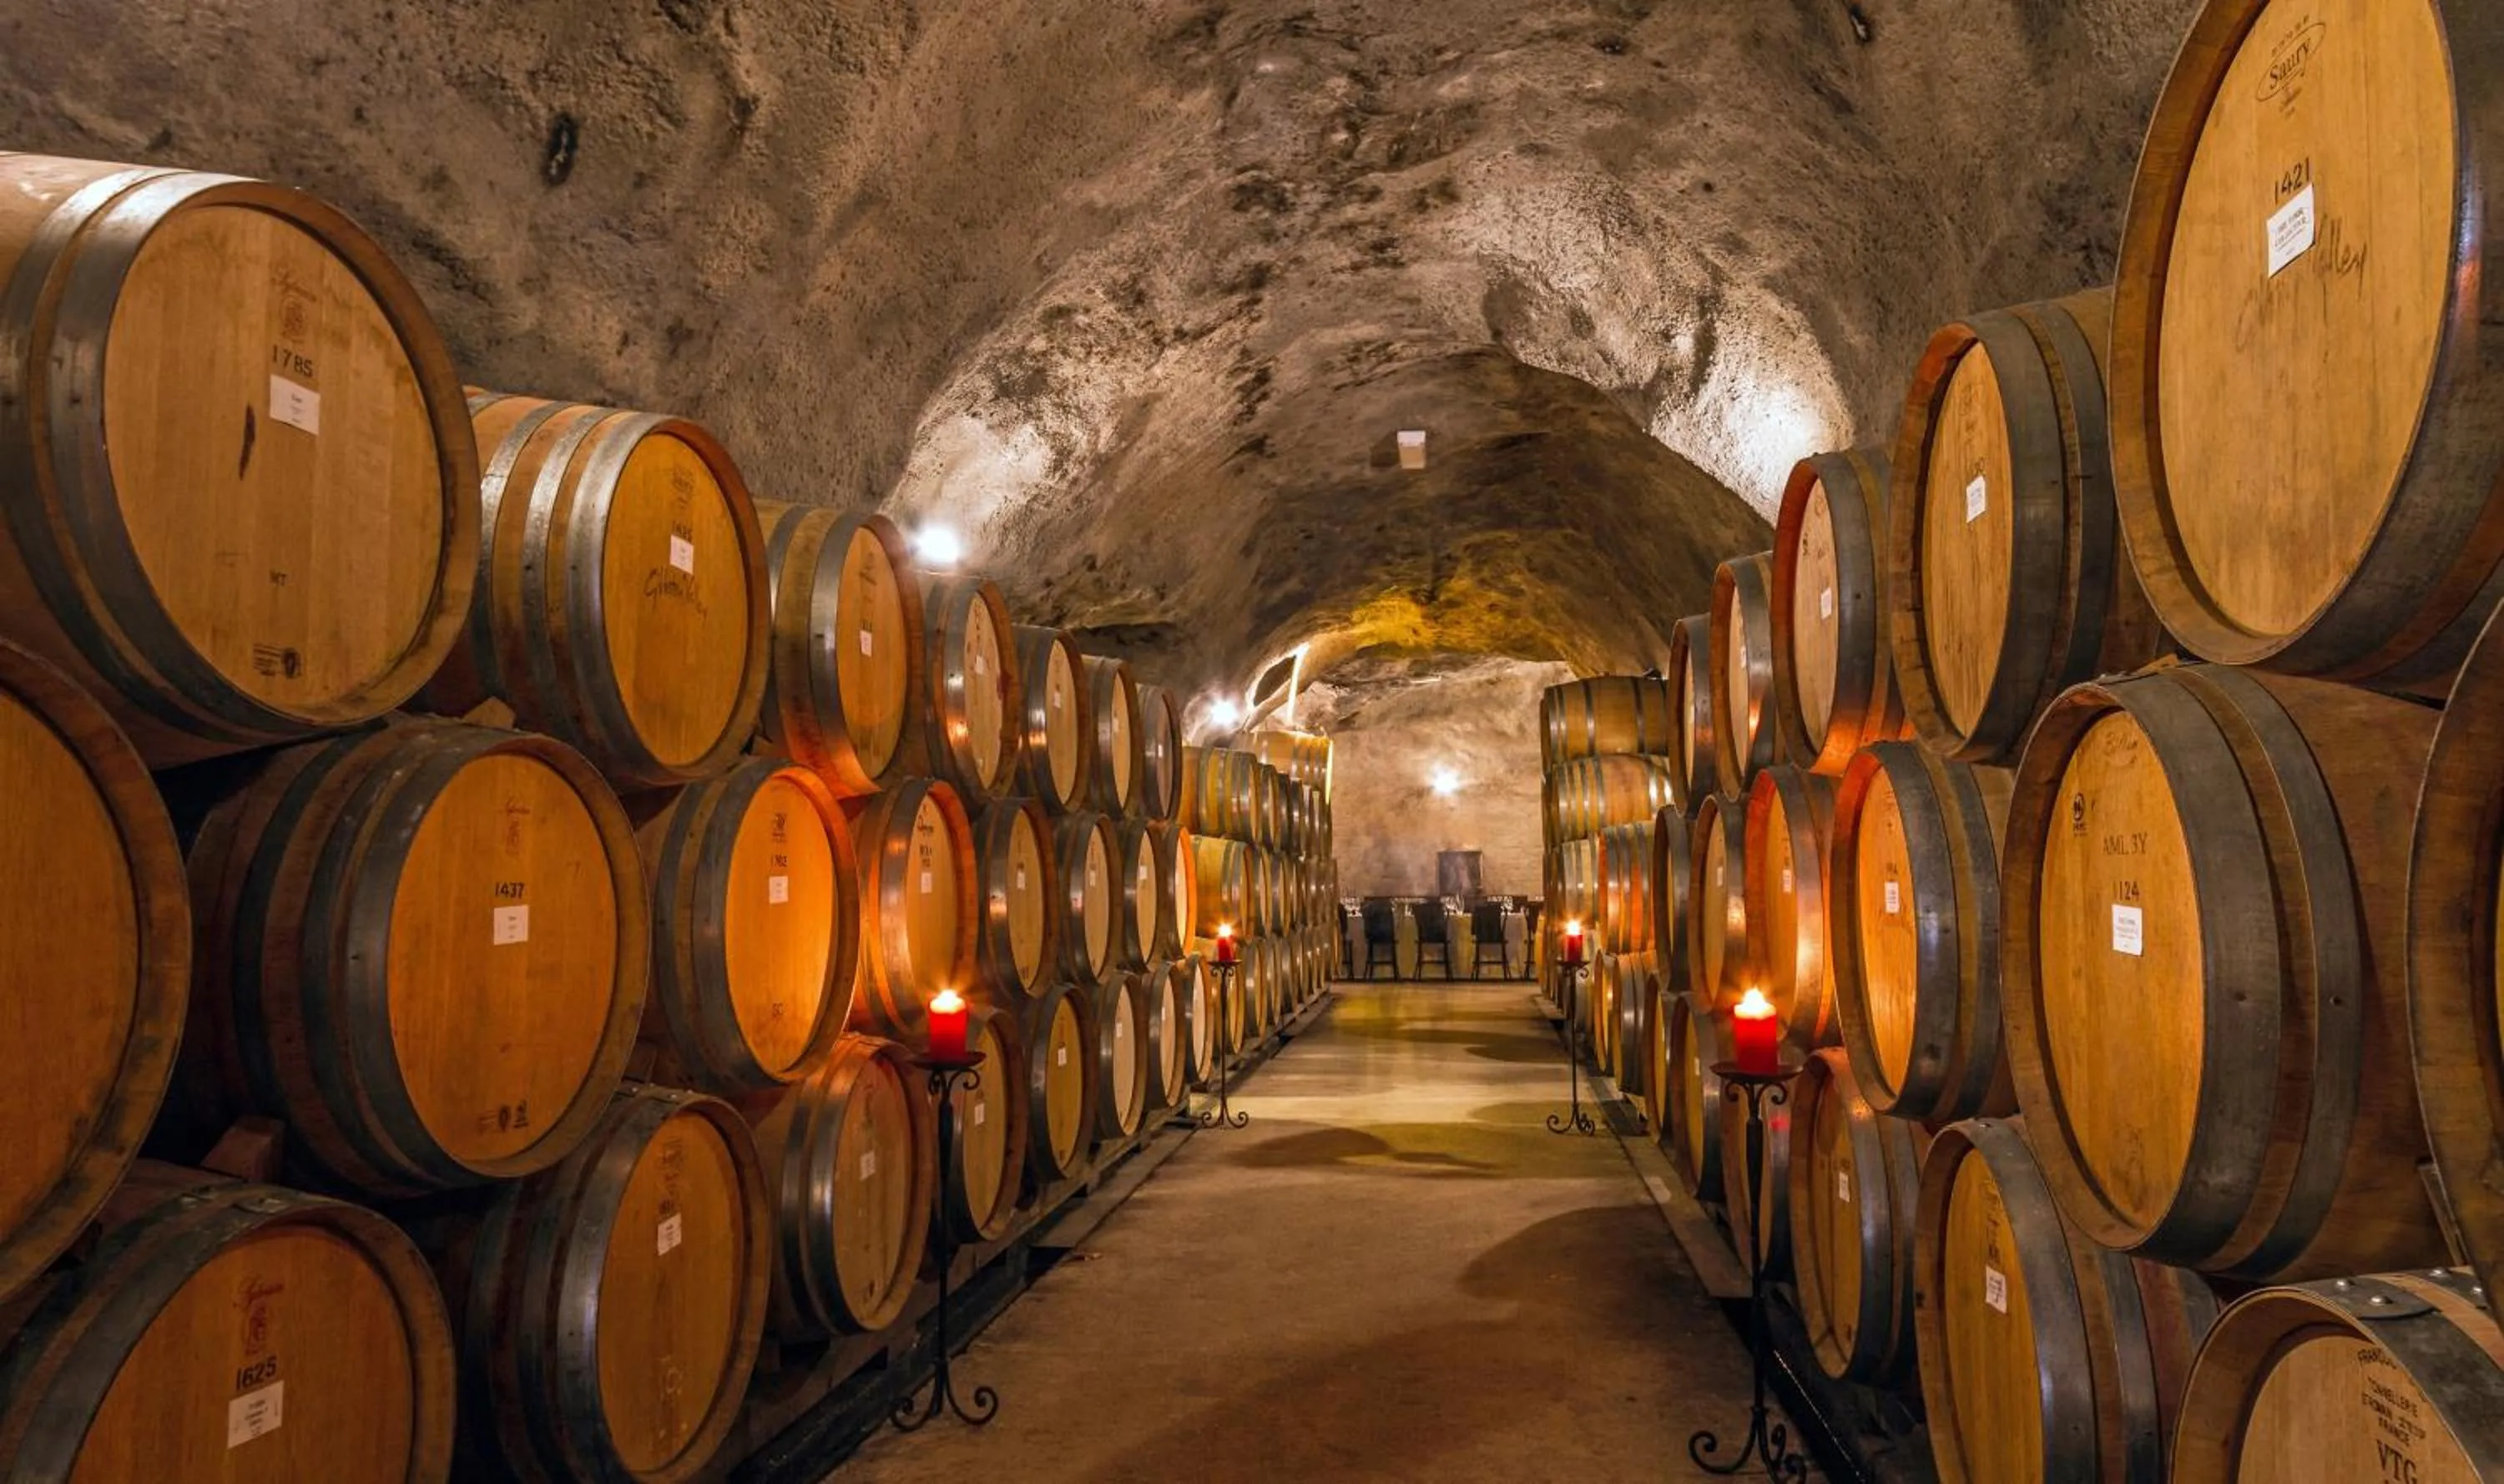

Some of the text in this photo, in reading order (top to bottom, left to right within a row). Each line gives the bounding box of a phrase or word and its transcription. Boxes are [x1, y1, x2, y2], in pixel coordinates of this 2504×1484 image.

[2274, 156, 2310, 204] 1421
[494, 881, 525, 899] 1437
[235, 1354, 278, 1391] 1625
